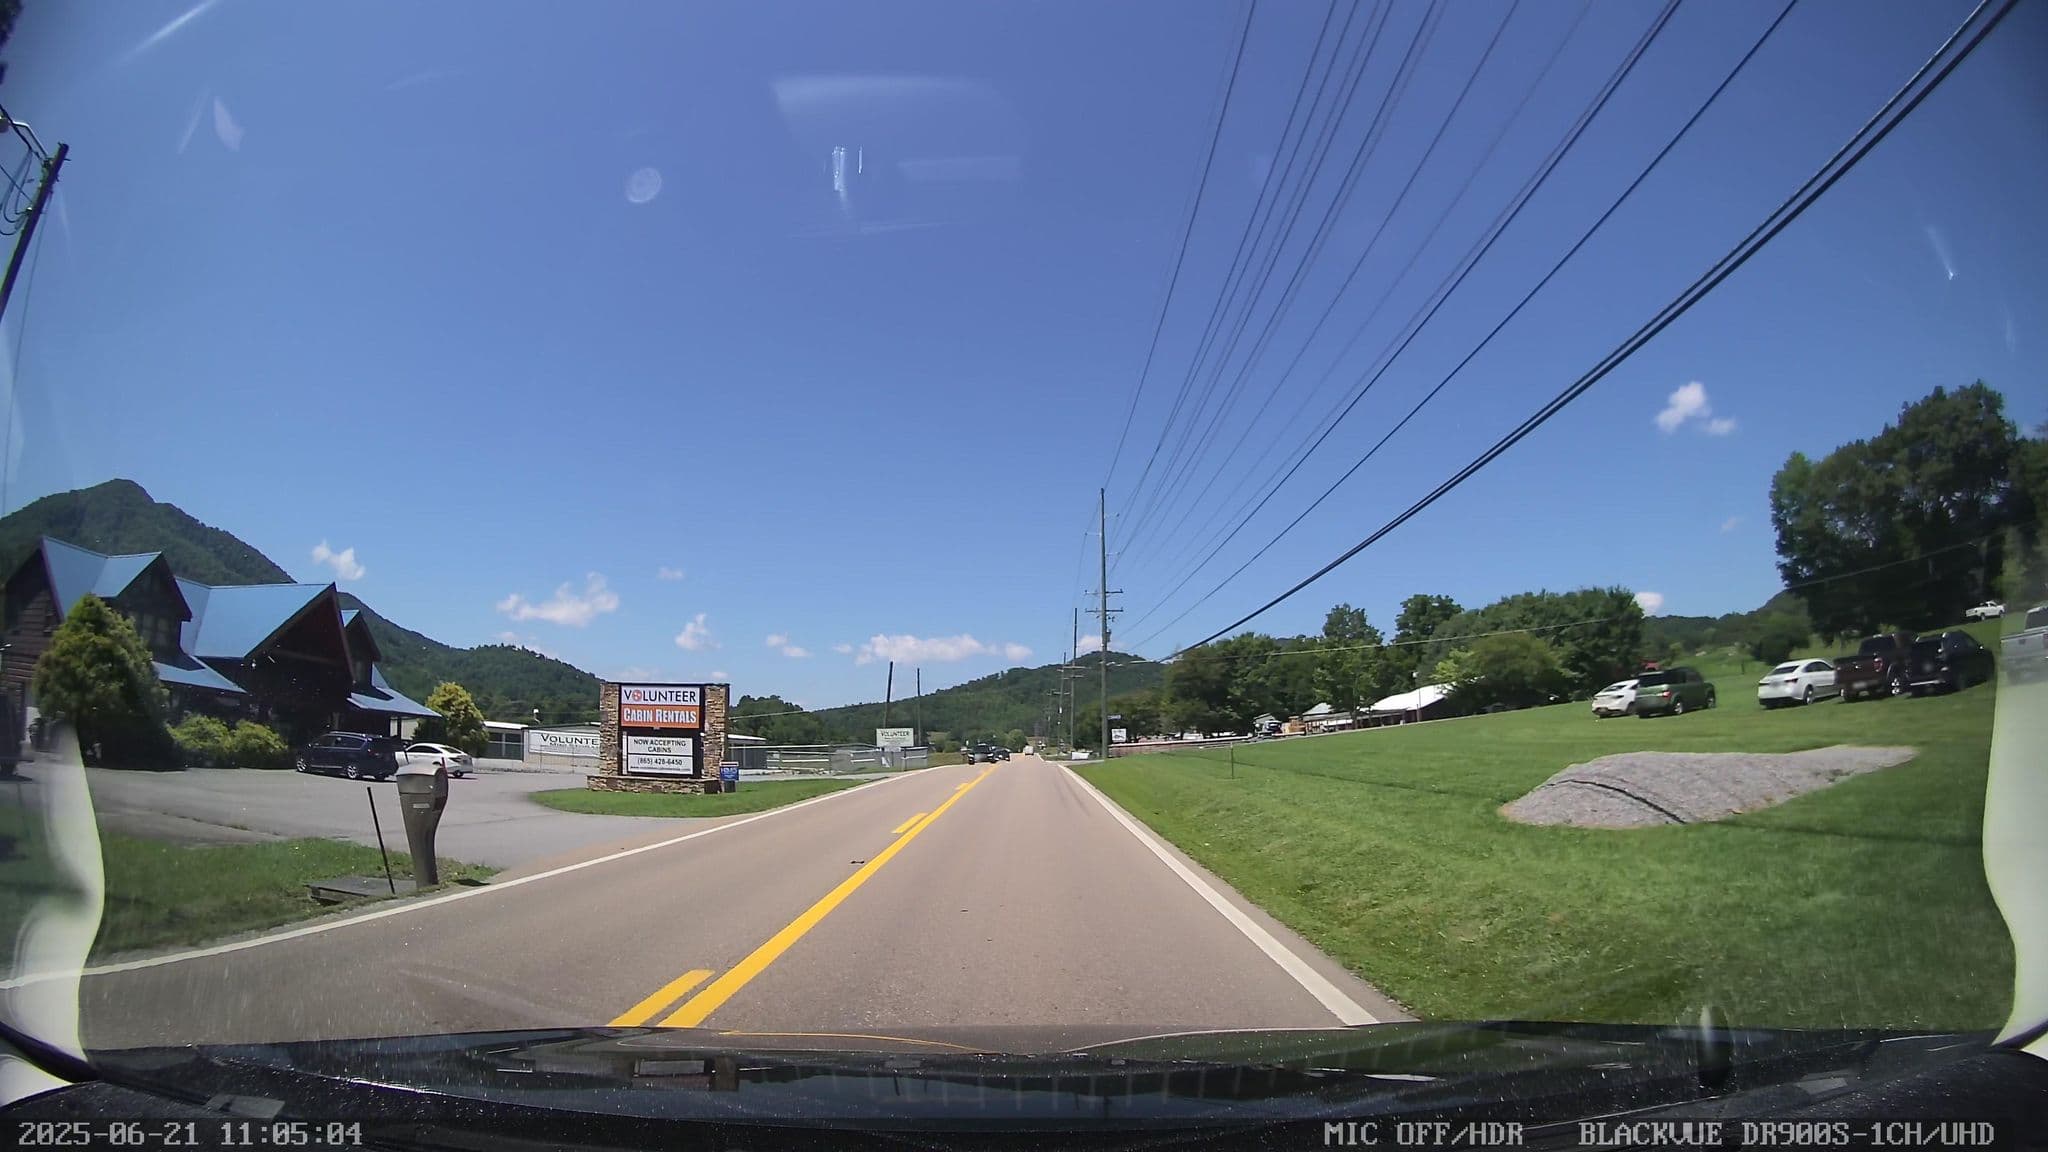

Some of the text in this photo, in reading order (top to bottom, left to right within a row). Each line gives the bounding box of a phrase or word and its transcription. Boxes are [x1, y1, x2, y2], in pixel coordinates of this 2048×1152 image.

[624, 689, 697, 702] VOLUNTEER
[623, 708, 697, 723] CABIN RENTALS
[649, 739, 687, 747] ACCEPTING
[637, 757, 653, 765] (865)
